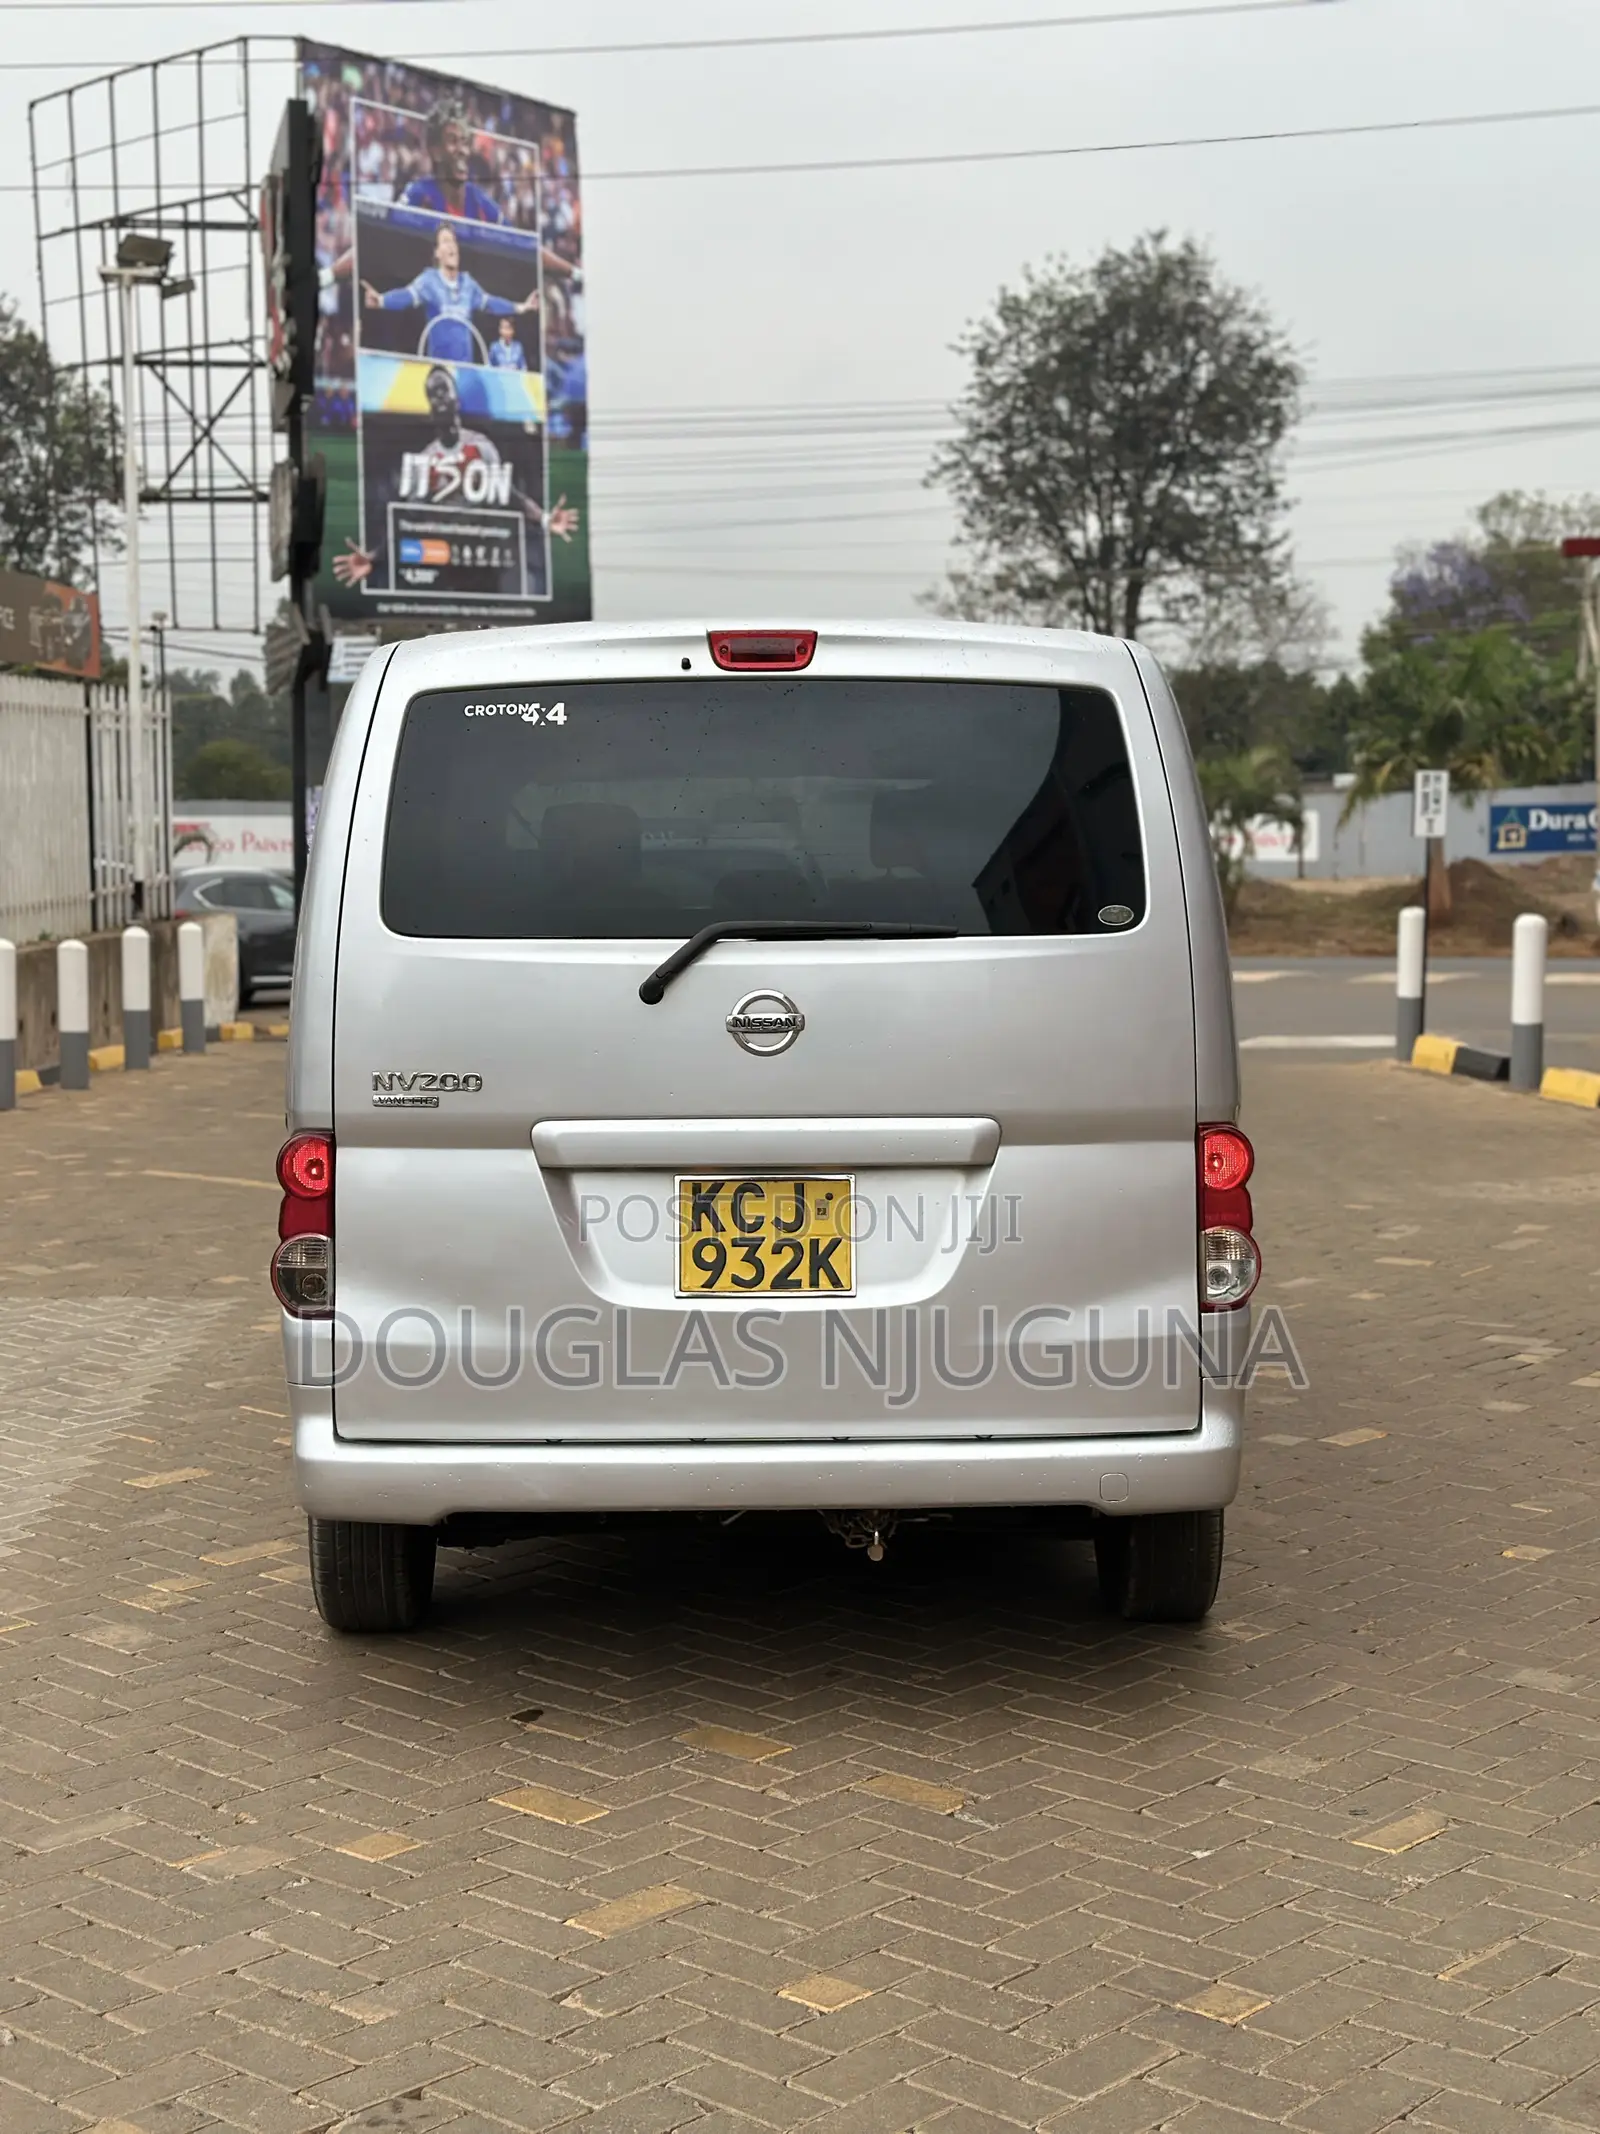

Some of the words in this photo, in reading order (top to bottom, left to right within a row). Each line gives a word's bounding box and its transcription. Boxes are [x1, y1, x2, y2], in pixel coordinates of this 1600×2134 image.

[463, 459, 513, 506] ON
[734, 1016, 796, 1028] NISSAN
[372, 1071, 483, 1092] NV200
[691, 1182, 806, 1233] KCJ
[692, 1237, 844, 1289] 932K
